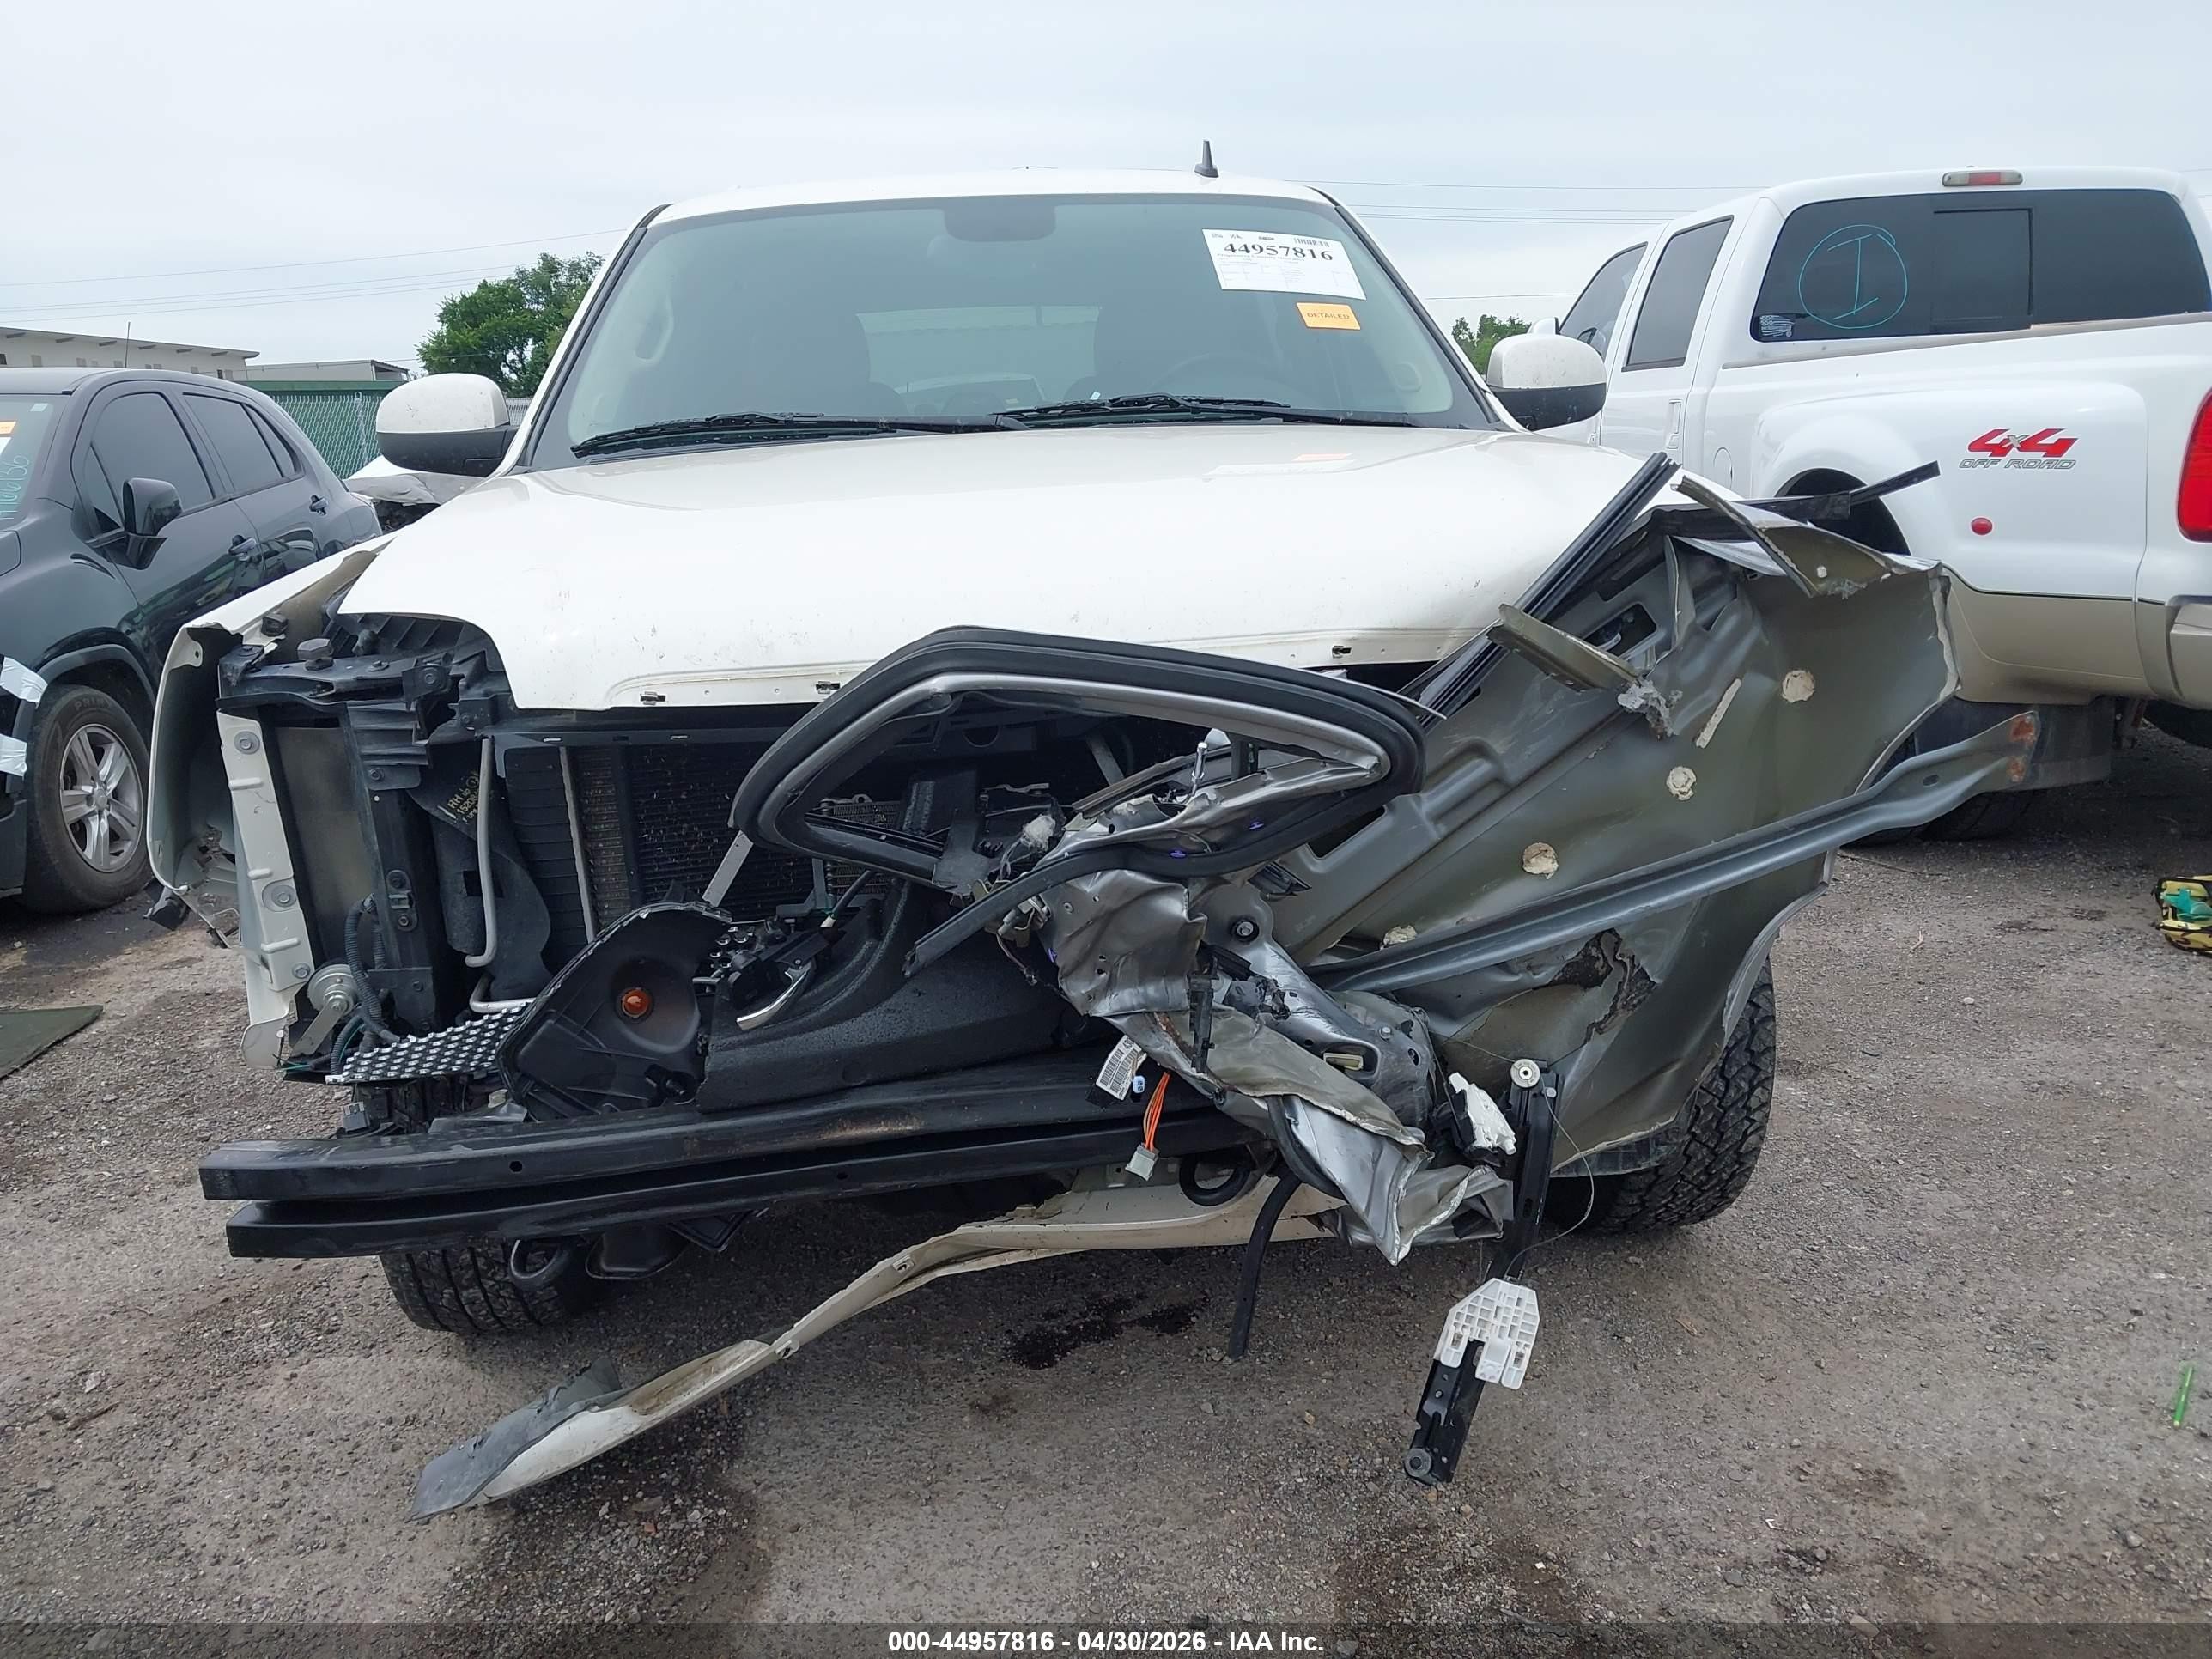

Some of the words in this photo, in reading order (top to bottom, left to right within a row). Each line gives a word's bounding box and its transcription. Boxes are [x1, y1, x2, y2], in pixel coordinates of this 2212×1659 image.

[1224, 243, 1333, 261] 44957816
[1959, 459, 2001, 469] OFF
[2004, 459, 2076, 470] ROAD
